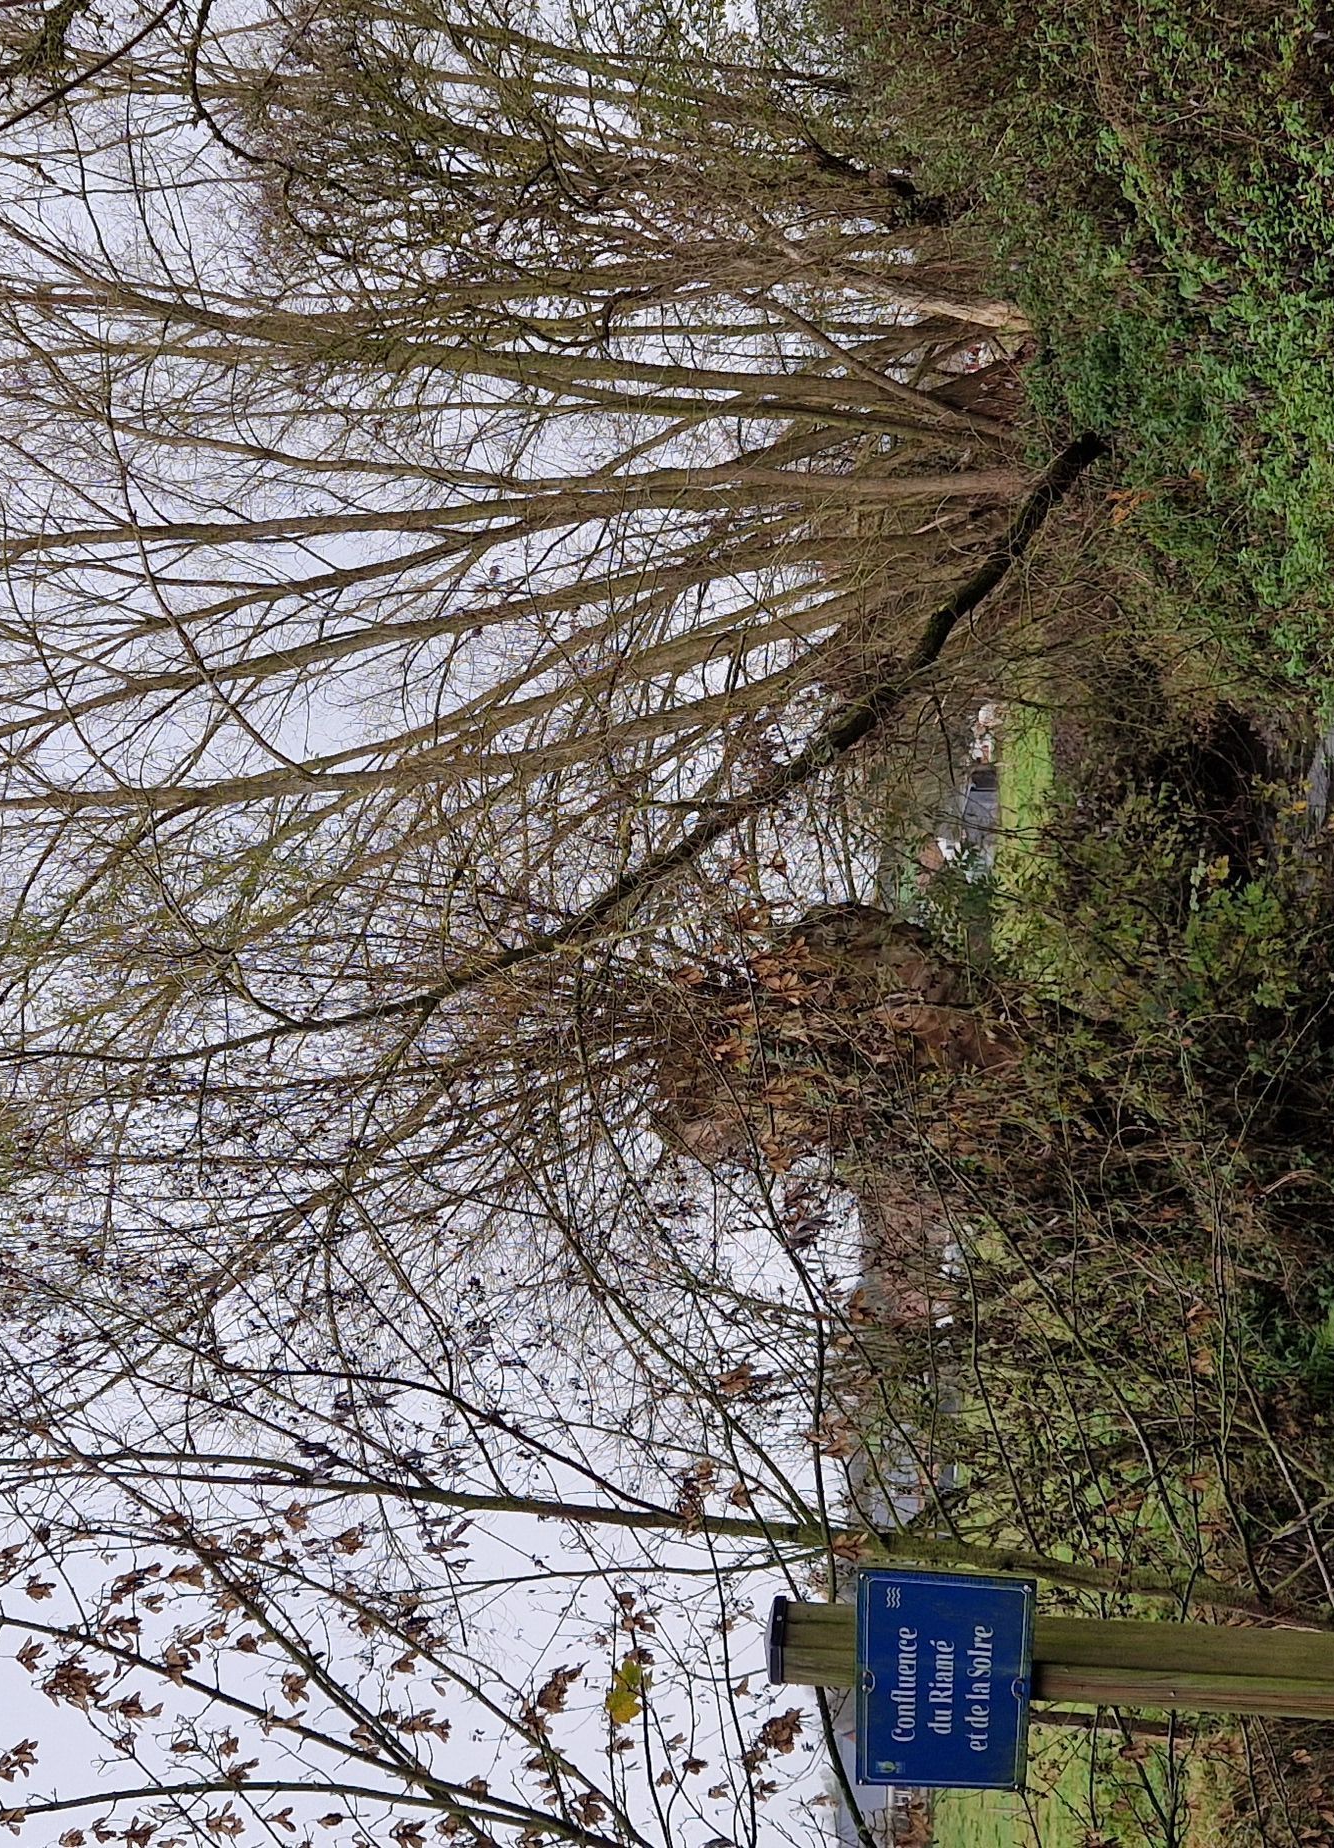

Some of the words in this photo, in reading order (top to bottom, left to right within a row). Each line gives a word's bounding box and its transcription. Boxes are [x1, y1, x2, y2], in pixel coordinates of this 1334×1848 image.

[966, 1625, 993, 1678] Solre
[891, 1626, 918, 1742] Confluence
[928, 1640, 955, 1703] Riamé
[965, 1682, 990, 1700] la
[927, 1709, 953, 1734] du
[964, 1704, 990, 1729] de
[966, 1733, 988, 1751] et
